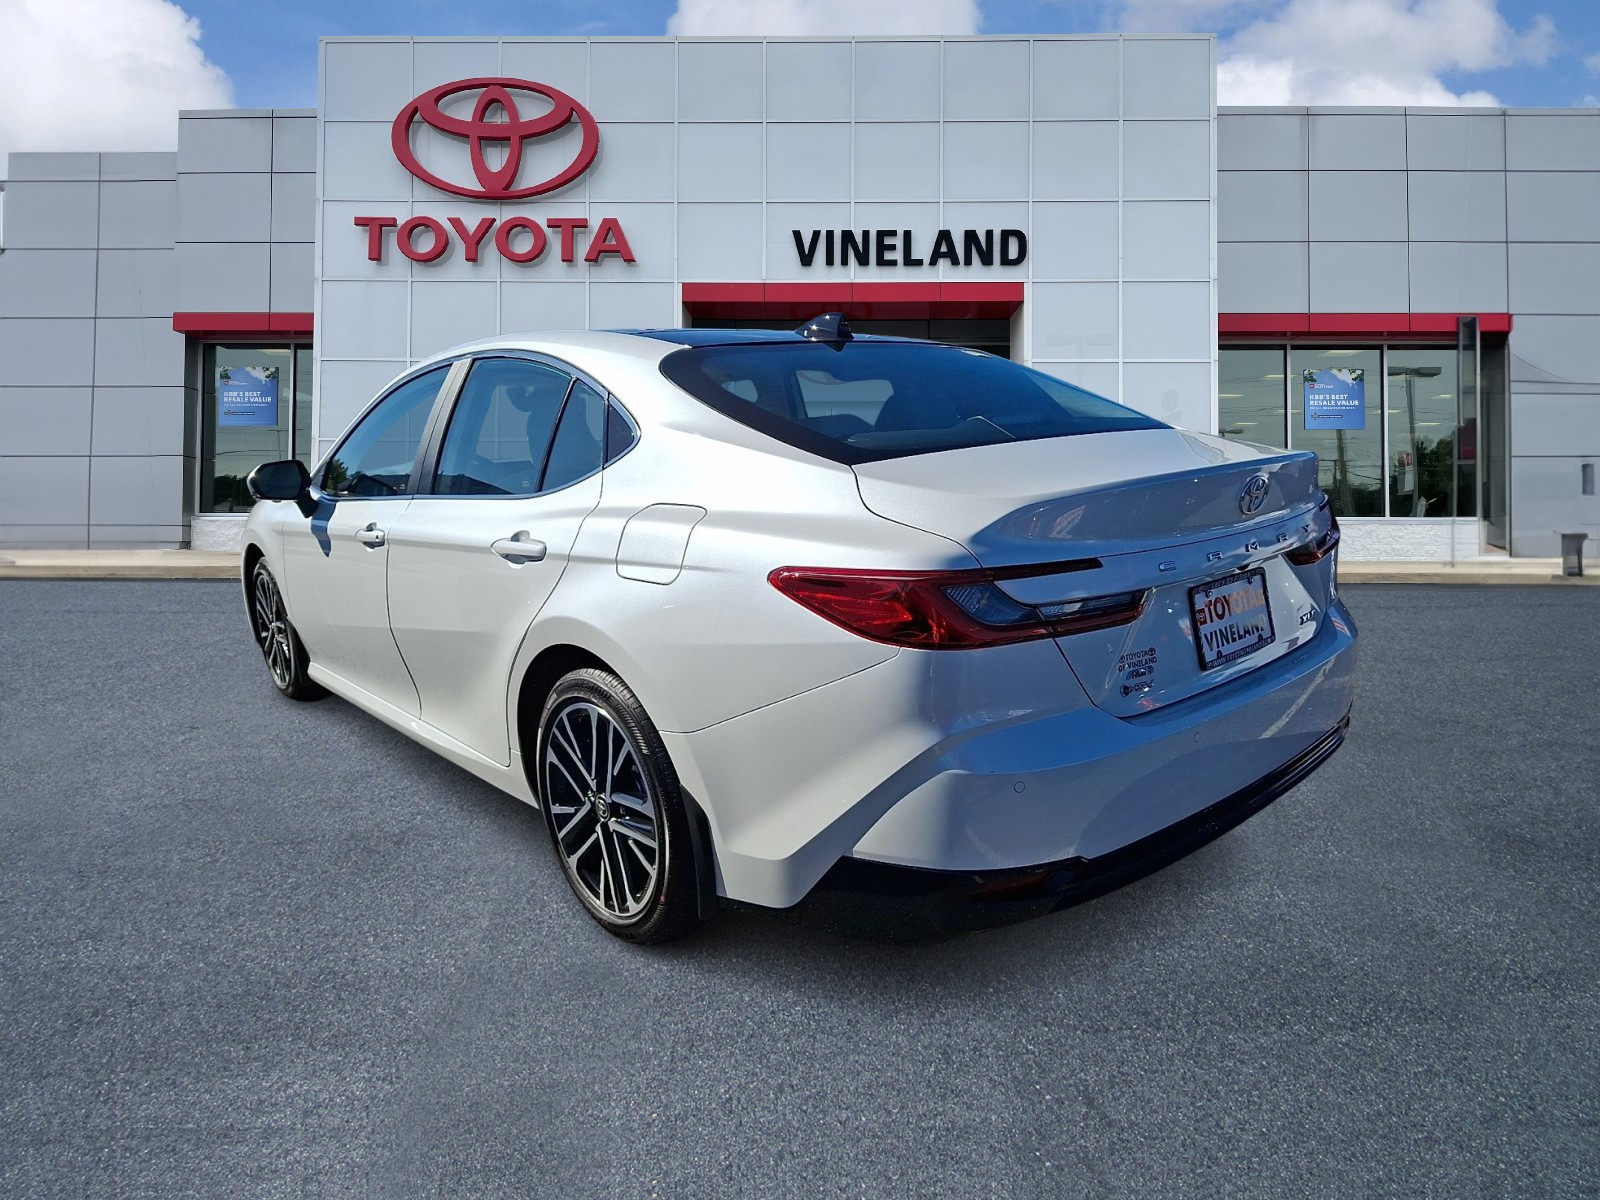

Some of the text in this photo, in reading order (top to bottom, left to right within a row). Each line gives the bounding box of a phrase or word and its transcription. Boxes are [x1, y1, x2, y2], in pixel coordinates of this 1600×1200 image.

[354, 216, 636, 264] TOYOTA
[792, 229, 1028, 267] VINELAND
[1158, 523, 1311, 572] CAMRY
[1203, 614, 1266, 651] VINELAN
[1125, 650, 1148, 661] TOYOTA
[1127, 656, 1157, 669] VINELAND
